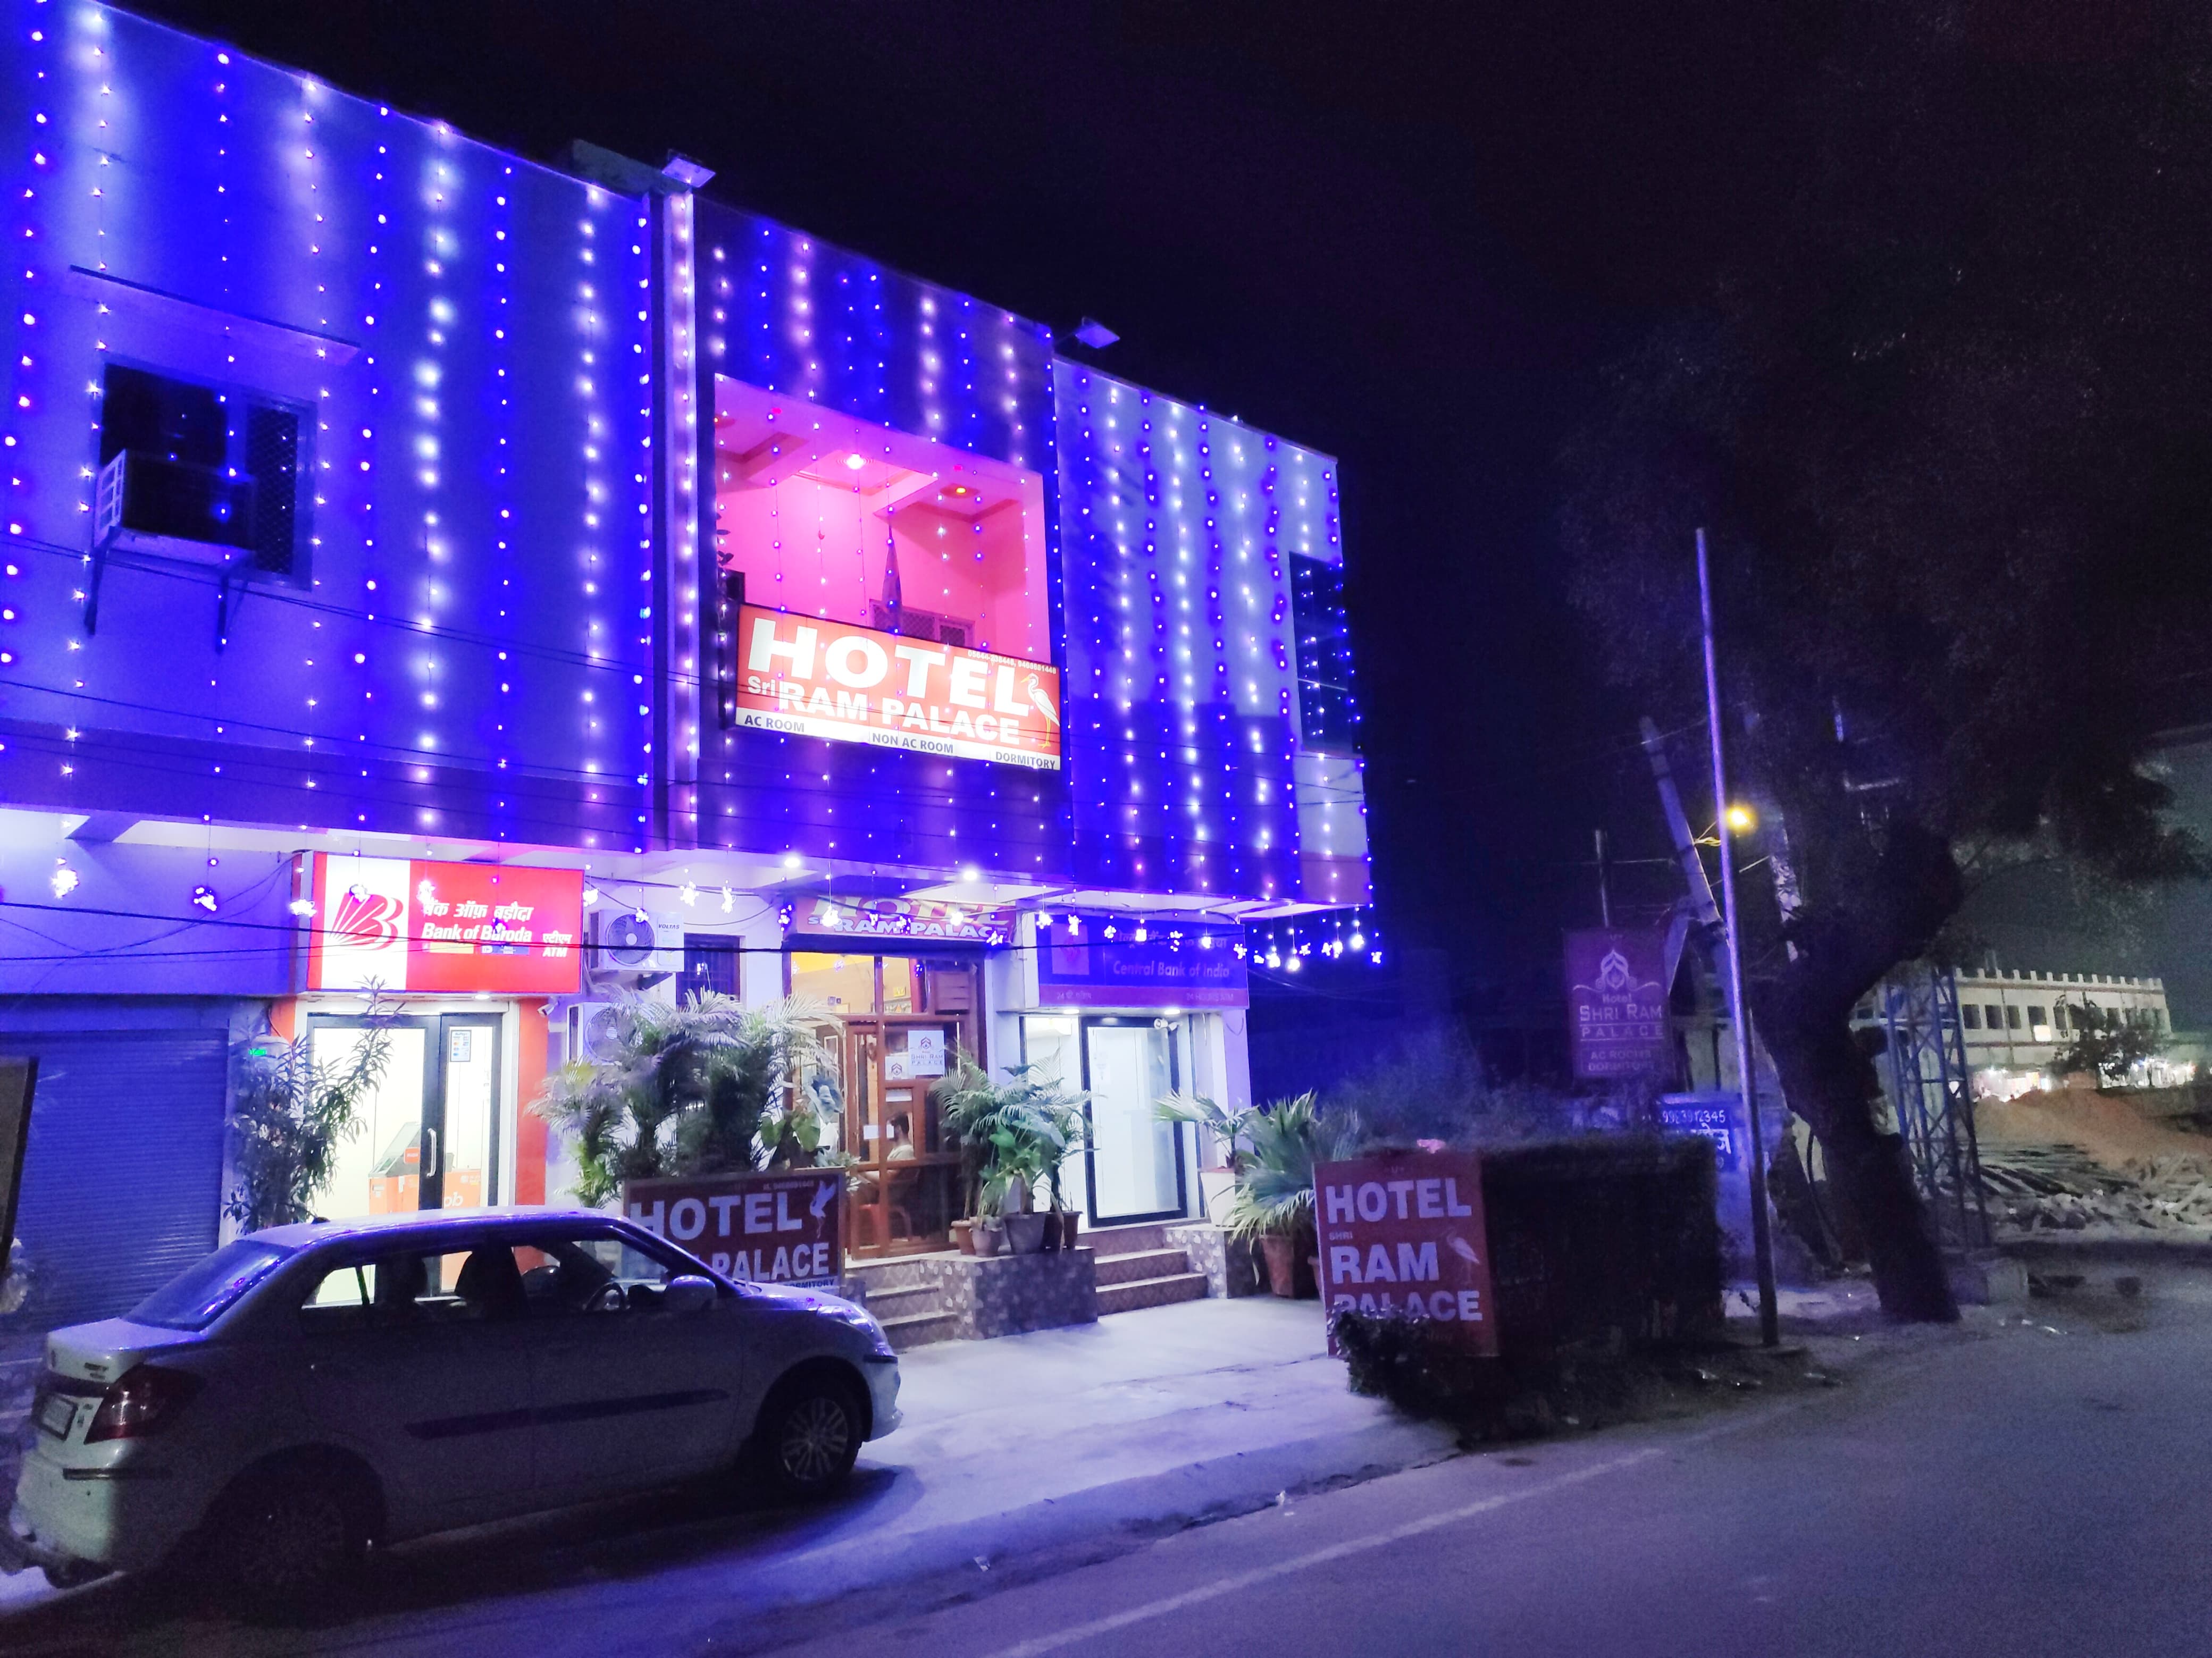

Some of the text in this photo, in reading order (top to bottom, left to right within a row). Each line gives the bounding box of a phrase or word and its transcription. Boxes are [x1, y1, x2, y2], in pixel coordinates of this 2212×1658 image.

[748, 617, 1030, 717] HOTEL
[747, 676, 1020, 745] Sri RAM PALACE
[744, 716, 805, 733] AC ROOM
[872, 733, 954, 754] NON AC ROOM
[995, 751, 1056, 769] DORMITORY
[810, 897, 1010, 925] HOTEL
[421, 922, 533, 942] Bank of Baroda
[834, 919, 901, 934] RAM
[910, 922, 1009, 939] PALACE
[542, 946, 568, 958] ATM
[1113, 961, 1230, 978] Central Bank of India
[1580, 1003, 1662, 1021] SHRI RAM
[1581, 1025, 1664, 1038] PALACE
[1325, 1177, 1472, 1224] HOTEL
[629, 1191, 803, 1241] HOTEL
[1329, 1231, 1353, 1241] SHRI
[712, 1242, 830, 1284] PALACE
[1330, 1241, 1439, 1284] RAM
